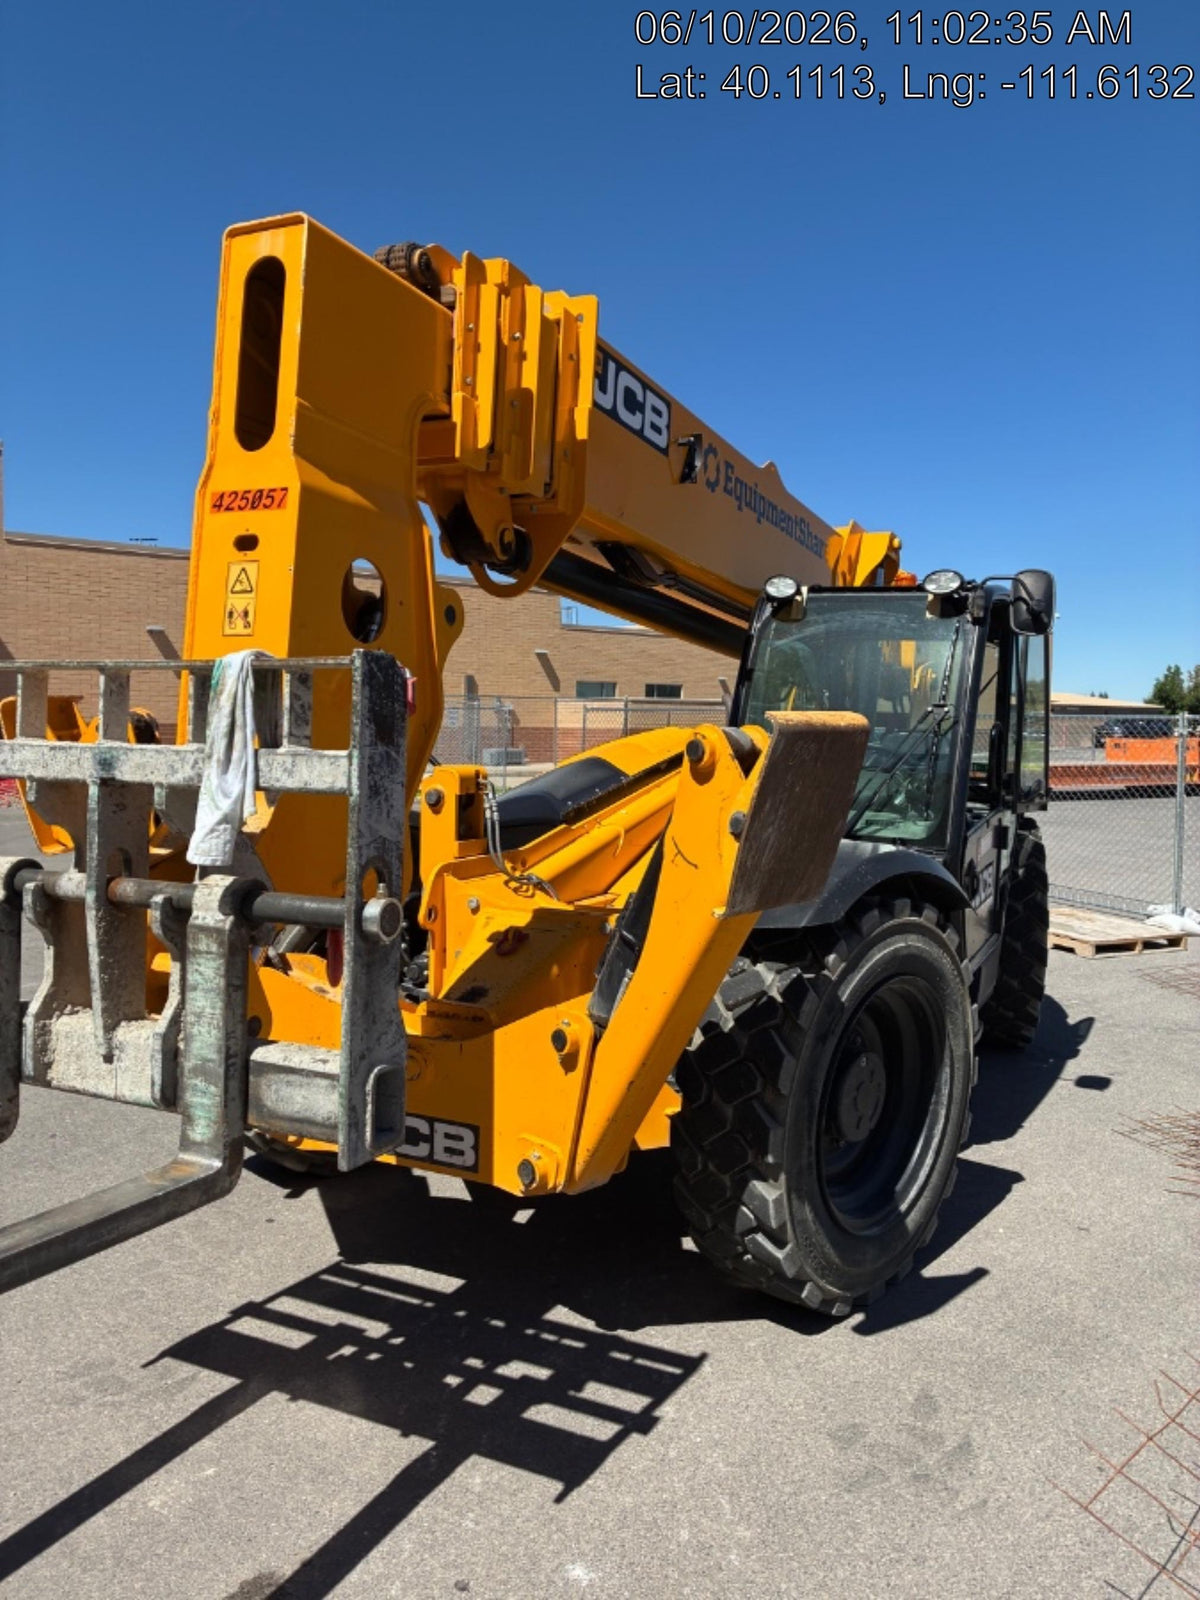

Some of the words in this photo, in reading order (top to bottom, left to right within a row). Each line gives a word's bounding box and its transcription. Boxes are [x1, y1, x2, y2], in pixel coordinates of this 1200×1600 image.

[594, 359, 669, 449] JCB
[212, 486, 289, 512] 425057
[723, 460, 826, 559] EquipmentShar
[395, 1114, 476, 1167] CB
